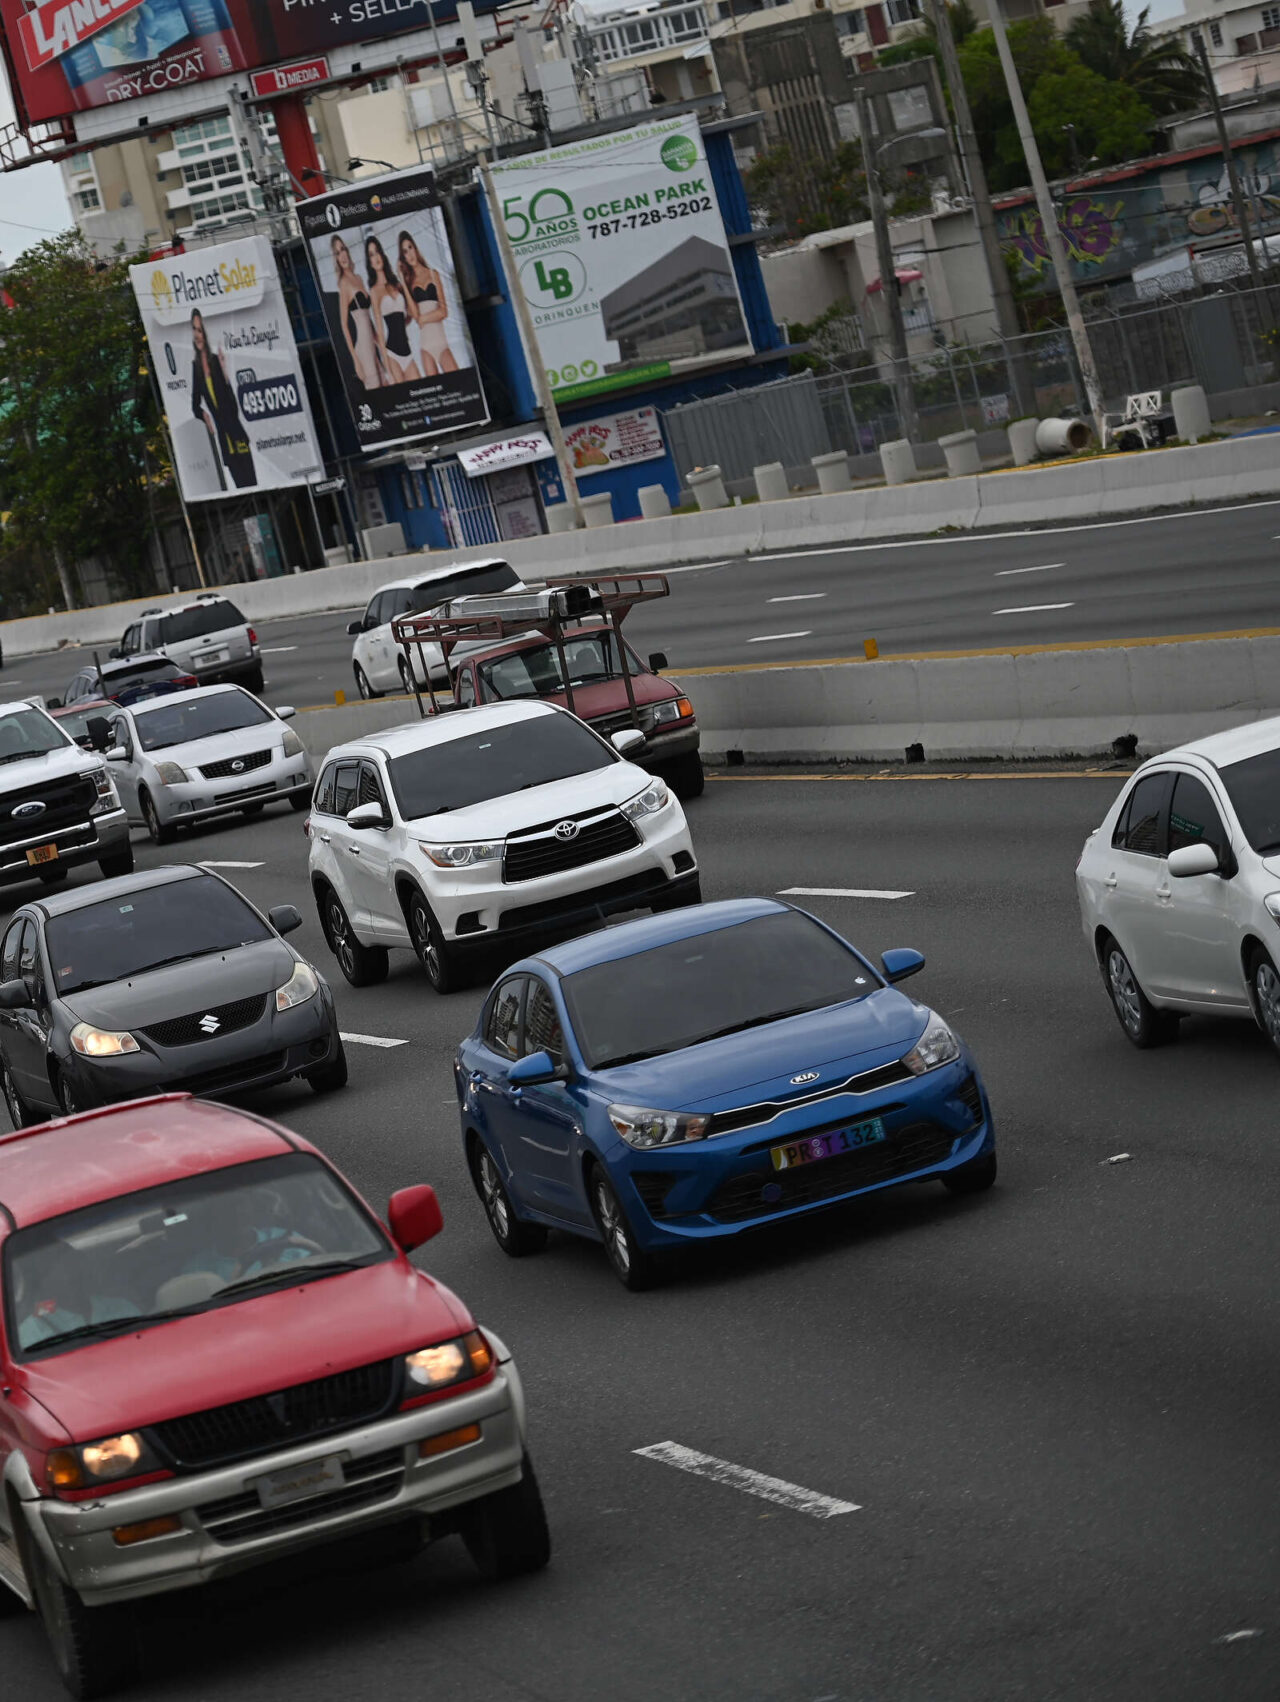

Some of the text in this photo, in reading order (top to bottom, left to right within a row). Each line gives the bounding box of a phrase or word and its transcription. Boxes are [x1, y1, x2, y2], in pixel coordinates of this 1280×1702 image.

[287, 67, 320, 85] MEDIA
[583, 178, 707, 222] OCEAN PARK
[535, 217, 579, 237] AÑOS
[587, 196, 713, 240] 787-728-5202
[513, 234, 582, 257] ABORATORIOS
[534, 302, 600, 325] ORINQUEN
[242, 383, 298, 415] 493-0700
[794, 1071, 816, 1083] KIA
[786, 1142, 812, 1165] PR
[839, 1124, 875, 1150] 132
